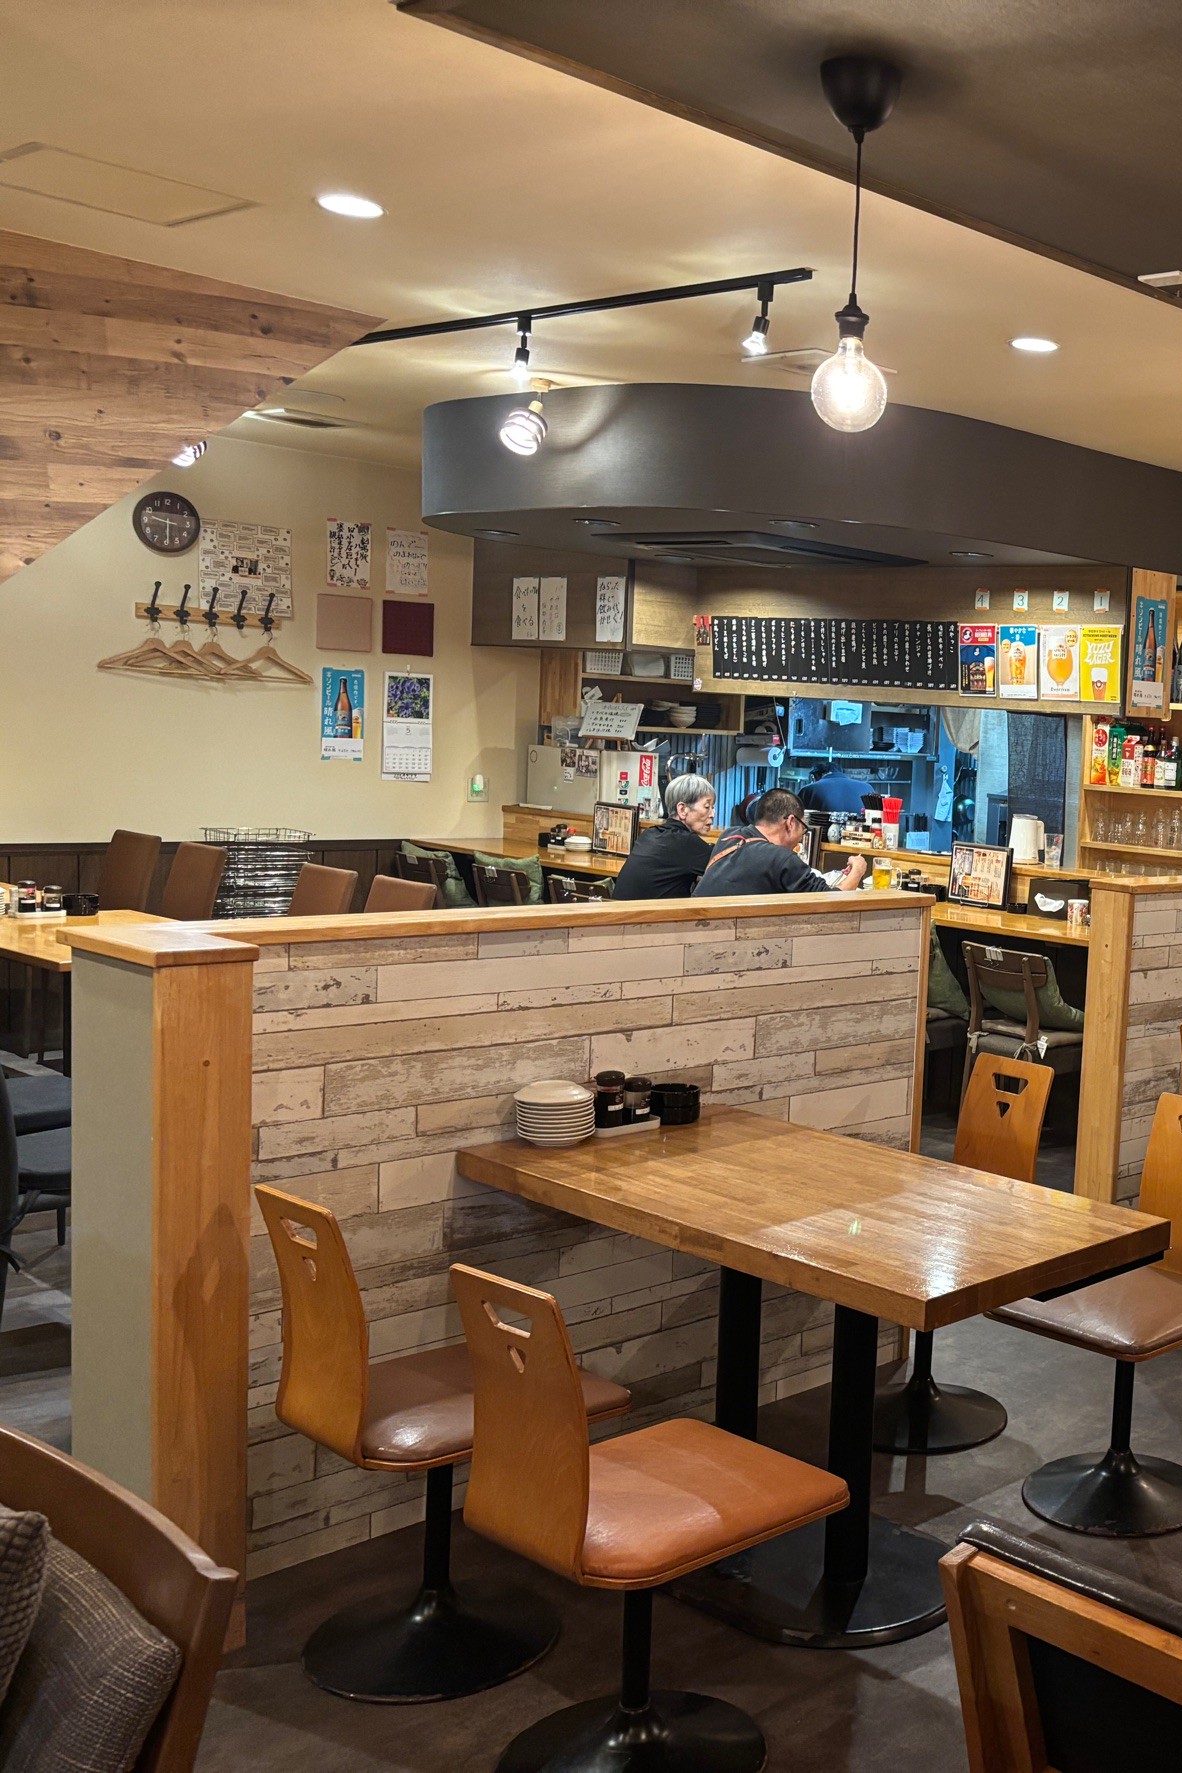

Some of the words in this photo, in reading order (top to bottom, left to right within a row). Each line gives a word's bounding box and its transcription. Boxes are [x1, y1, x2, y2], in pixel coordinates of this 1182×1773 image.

[977, 594, 986, 606] 4
[1017, 594, 1025, 607] 3
[1056, 596, 1064, 606] 2
[1100, 596, 1103, 607] 1
[1086, 641, 1114, 655] YUZU
[1084, 653, 1115, 665] LAGER
